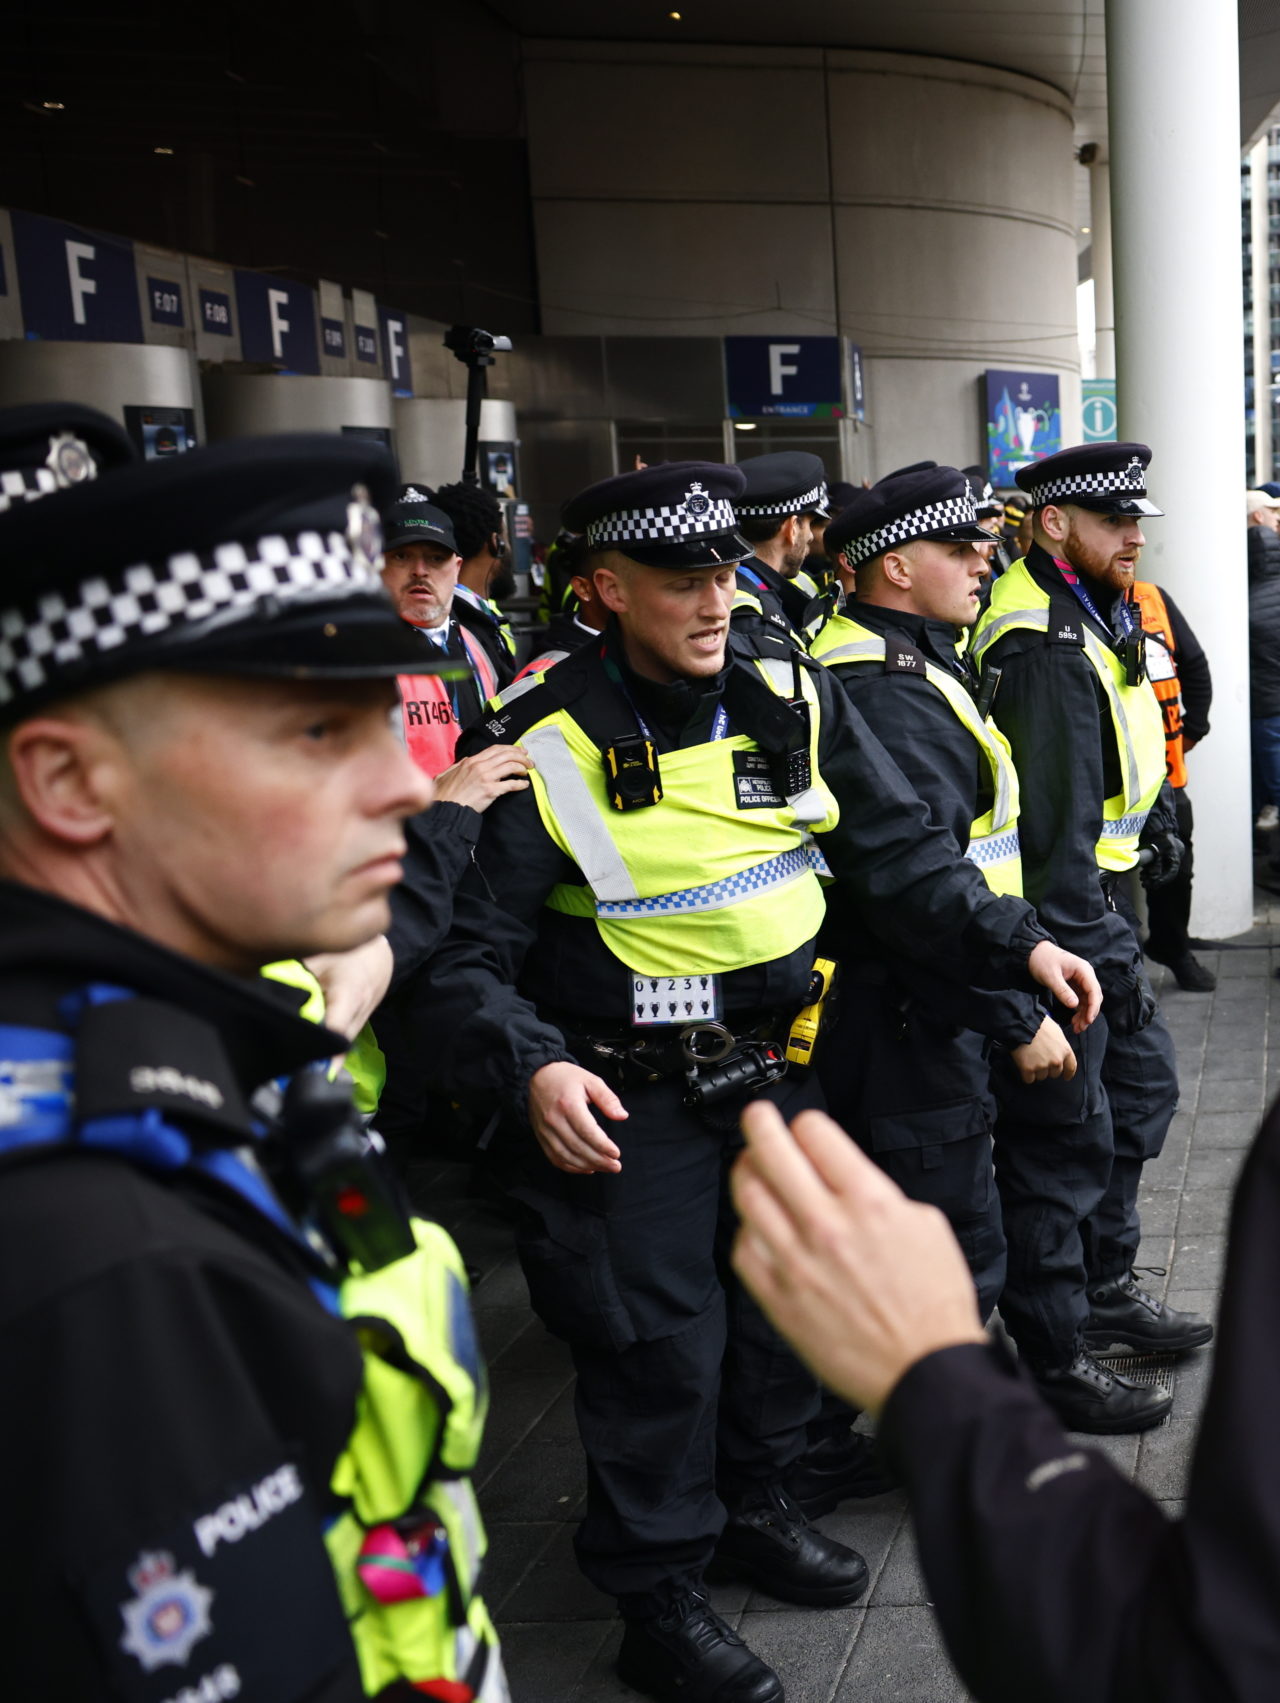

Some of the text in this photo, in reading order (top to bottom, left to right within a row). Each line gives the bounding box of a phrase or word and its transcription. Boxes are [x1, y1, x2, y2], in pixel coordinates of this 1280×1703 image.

[65, 239, 96, 325] F
[268, 288, 289, 358] F
[387, 319, 404, 379] F
[768, 344, 801, 395] F
[762, 404, 809, 415] ENTRANCE
[1058, 631, 1078, 640] 5952
[898, 653, 914, 661] SW
[896, 660, 917, 668] 1677
[740, 795, 761, 803] POLICE
[668, 978, 676, 990] 2
[683, 978, 692, 990] 3
[194, 1462, 304, 1558] POLICE
